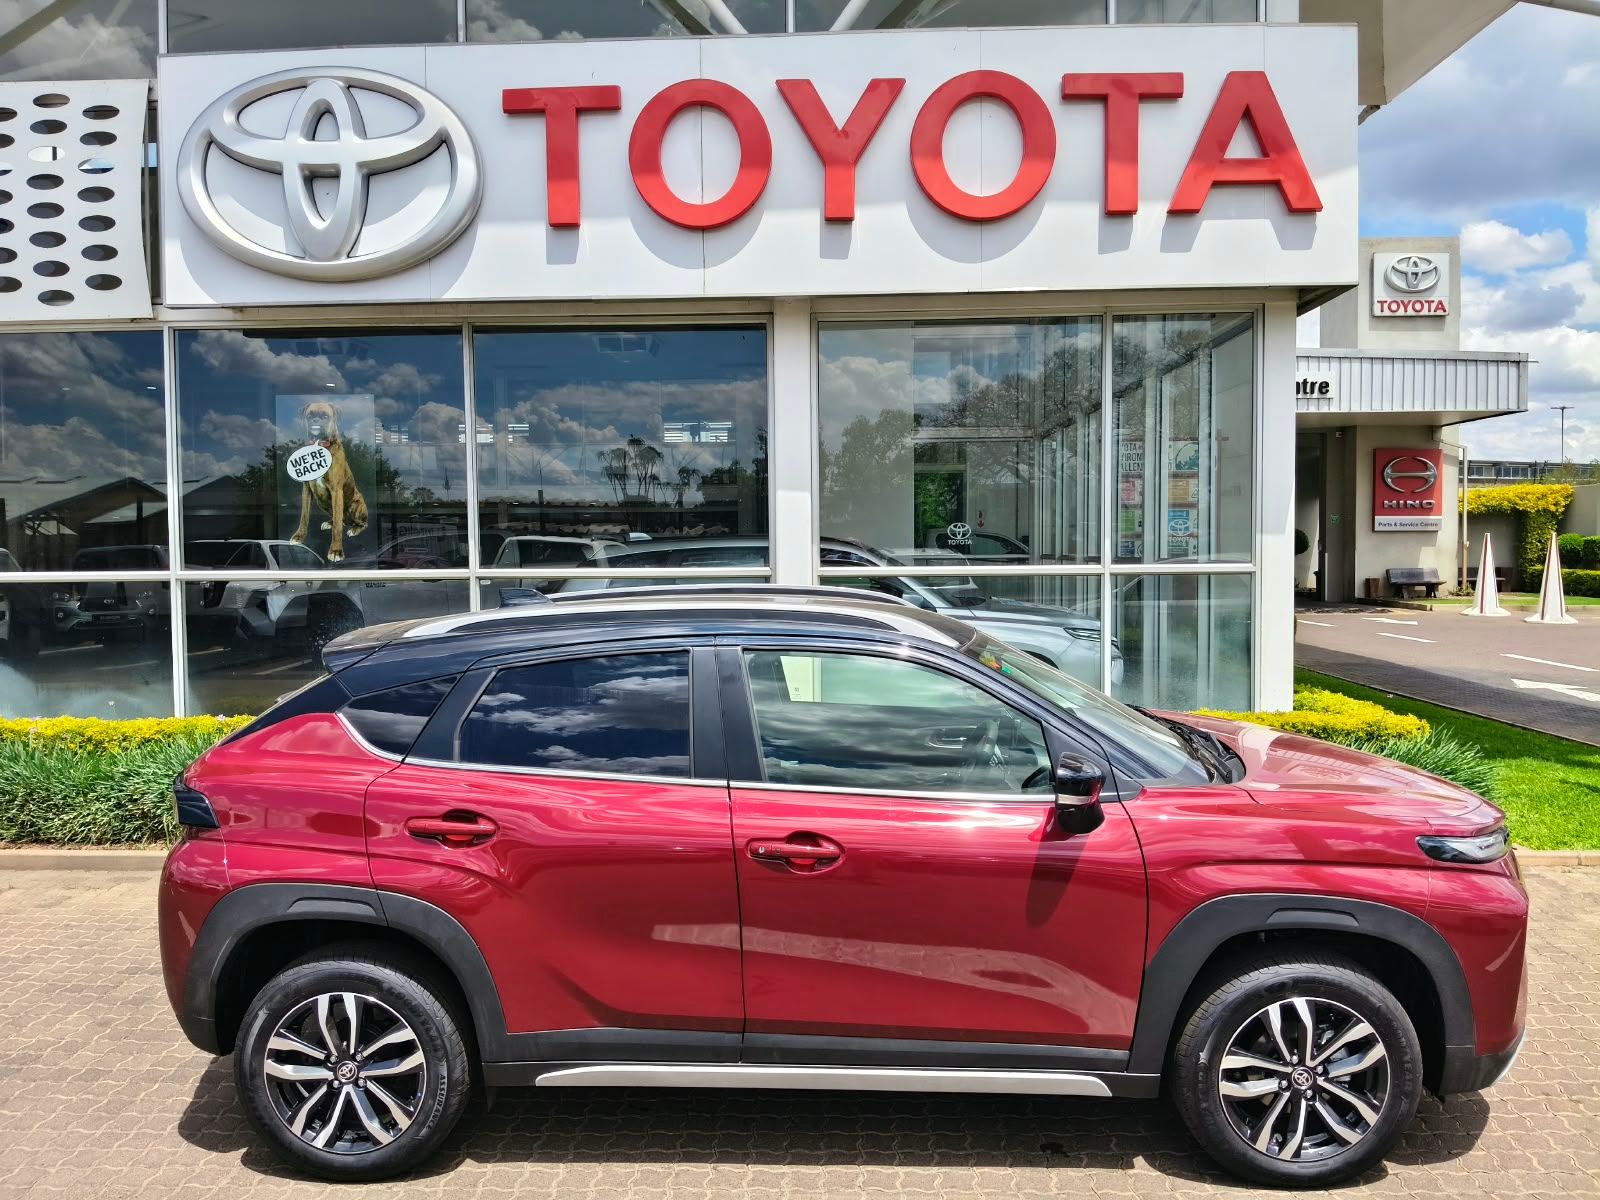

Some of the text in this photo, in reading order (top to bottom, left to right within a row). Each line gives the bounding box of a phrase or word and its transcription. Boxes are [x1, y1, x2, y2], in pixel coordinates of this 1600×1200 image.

[502, 69, 1323, 229] TOYOTA
[1377, 299, 1447, 314] TOYOTA
[290, 448, 326, 469] WE'RE
[295, 460, 328, 478] BACK!
[1383, 500, 1436, 509] HINO
[426, 1074, 446, 1130] ASSURANCE
